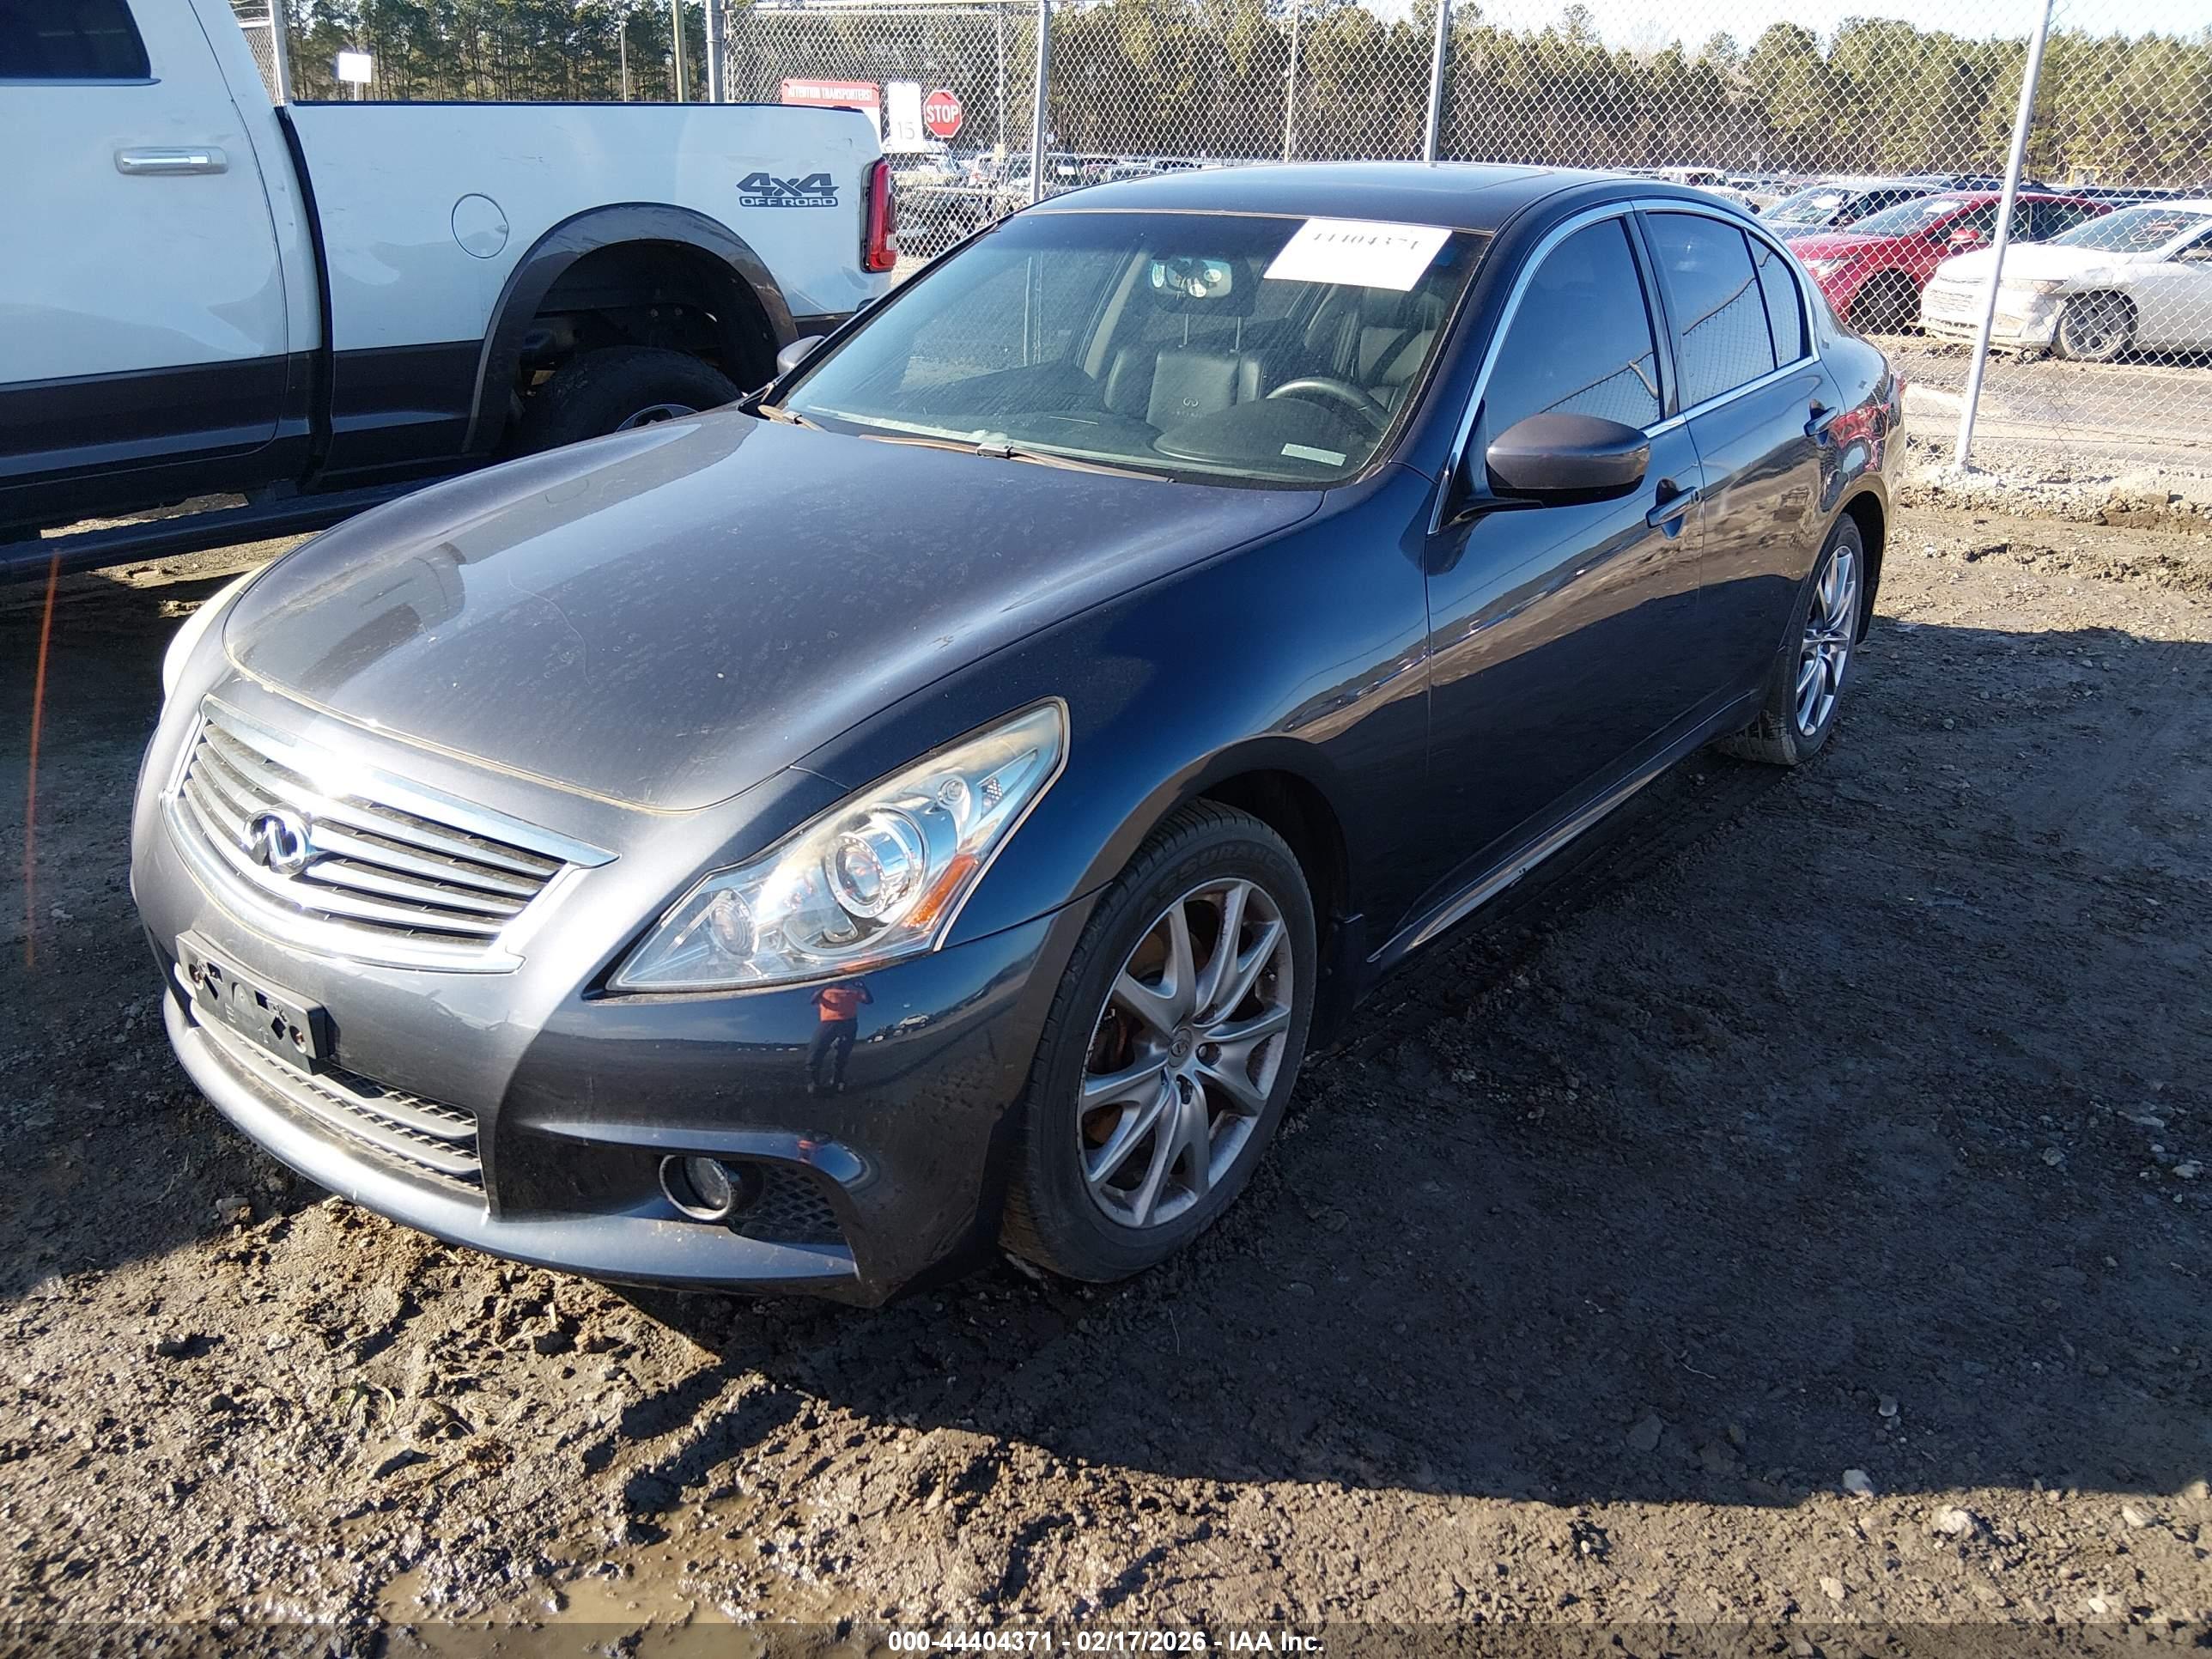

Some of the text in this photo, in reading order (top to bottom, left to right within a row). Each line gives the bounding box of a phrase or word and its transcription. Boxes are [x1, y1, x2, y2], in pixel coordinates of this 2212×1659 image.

[788, 86, 821, 99] ATTENTION
[927, 105, 959, 124] STOP
[898, 120, 915, 139] 15
[741, 198, 778, 206] OFF
